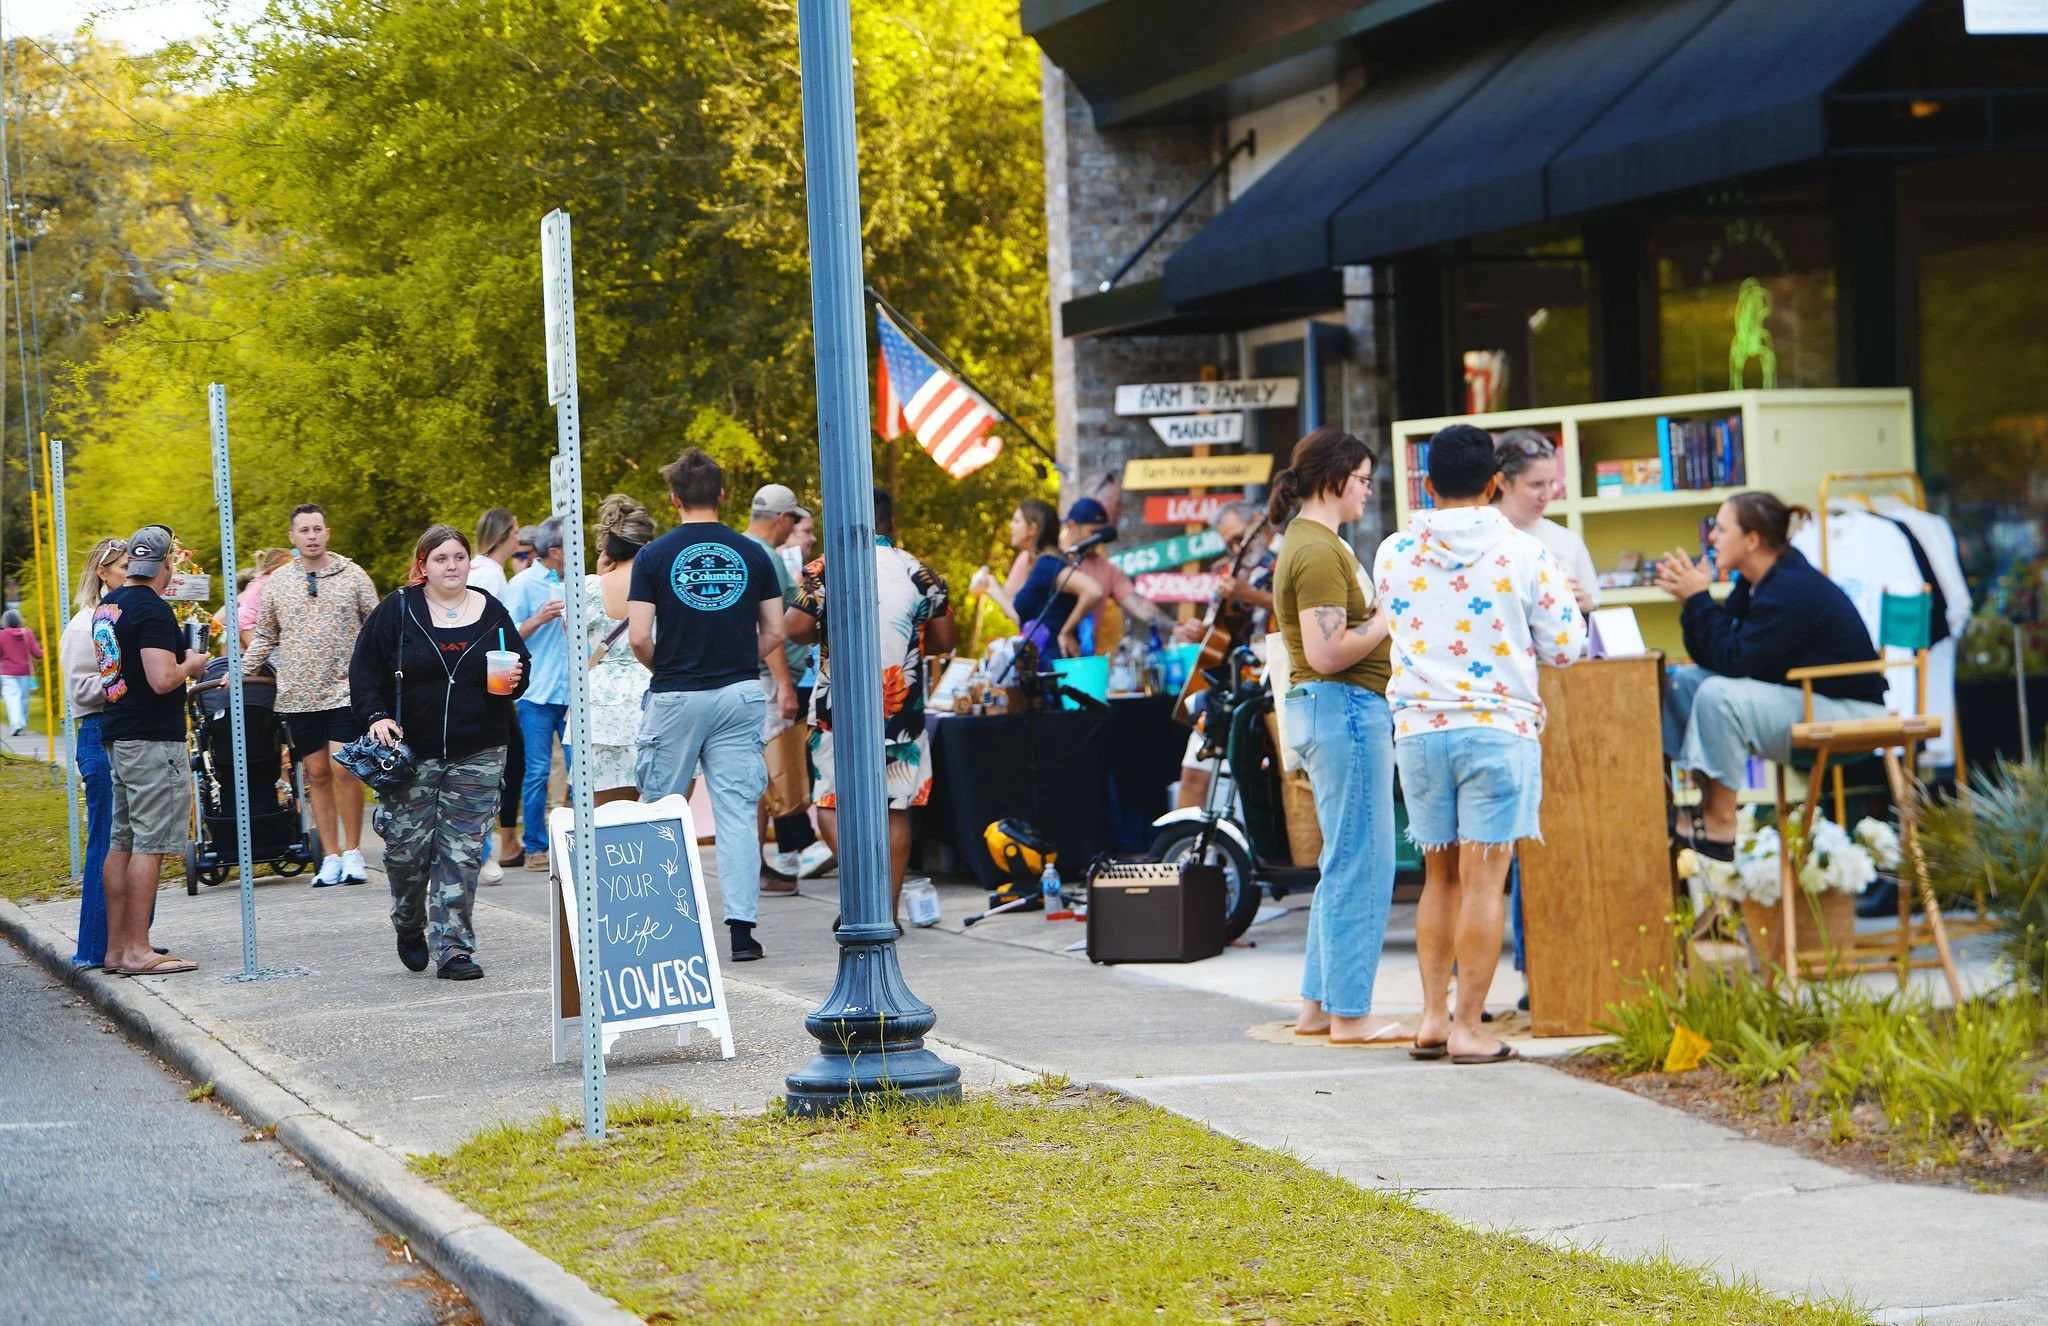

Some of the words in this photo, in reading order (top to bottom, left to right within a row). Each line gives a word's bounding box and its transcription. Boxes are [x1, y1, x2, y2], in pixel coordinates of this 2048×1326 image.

[1140, 384, 1183, 408] FARM
[1192, 385, 1210, 404] TO
[1217, 382, 1279, 405] FAMILY
[1169, 418, 1233, 440] MARKET
[675, 546, 711, 569] NORTHWEST
[689, 570, 742, 581] Columbia
[604, 841, 643, 866] BUY
[600, 873, 661, 902] YOUR
[598, 912, 673, 956] Wife
